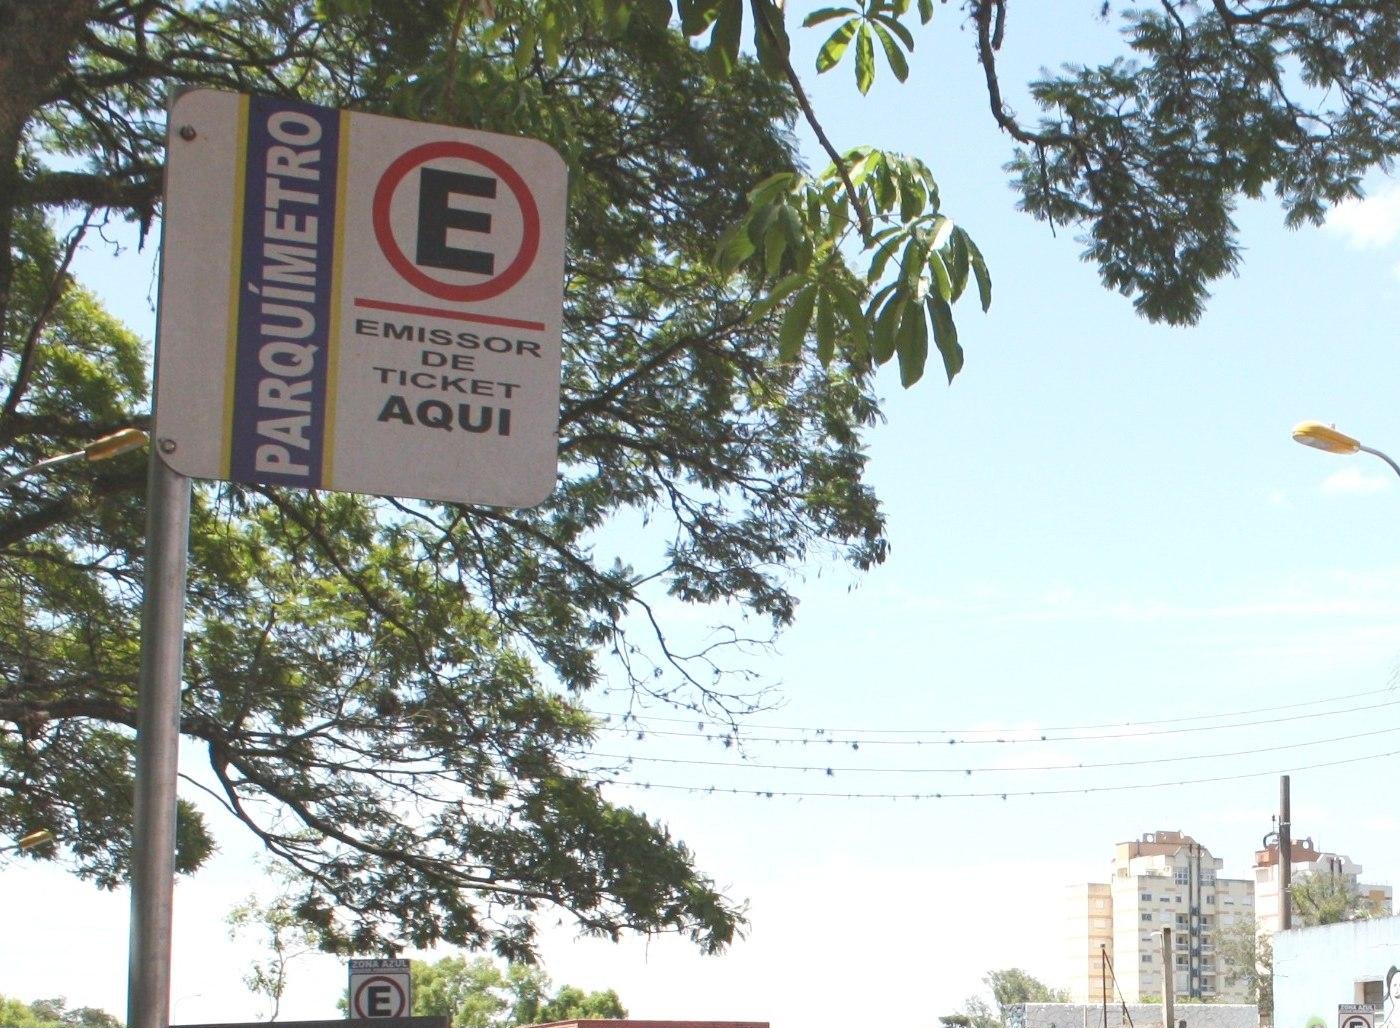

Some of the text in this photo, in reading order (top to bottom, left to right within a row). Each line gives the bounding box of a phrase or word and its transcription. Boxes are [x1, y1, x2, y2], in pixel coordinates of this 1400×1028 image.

[415, 167, 498, 276] E
[248, 110, 323, 477] PARQUÍMETRO
[354, 318, 543, 358] EMISSOR
[421, 349, 476, 373] DE
[373, 367, 521, 399] TICKET
[376, 395, 513, 437] AQUI
[368, 986, 392, 1016] E
